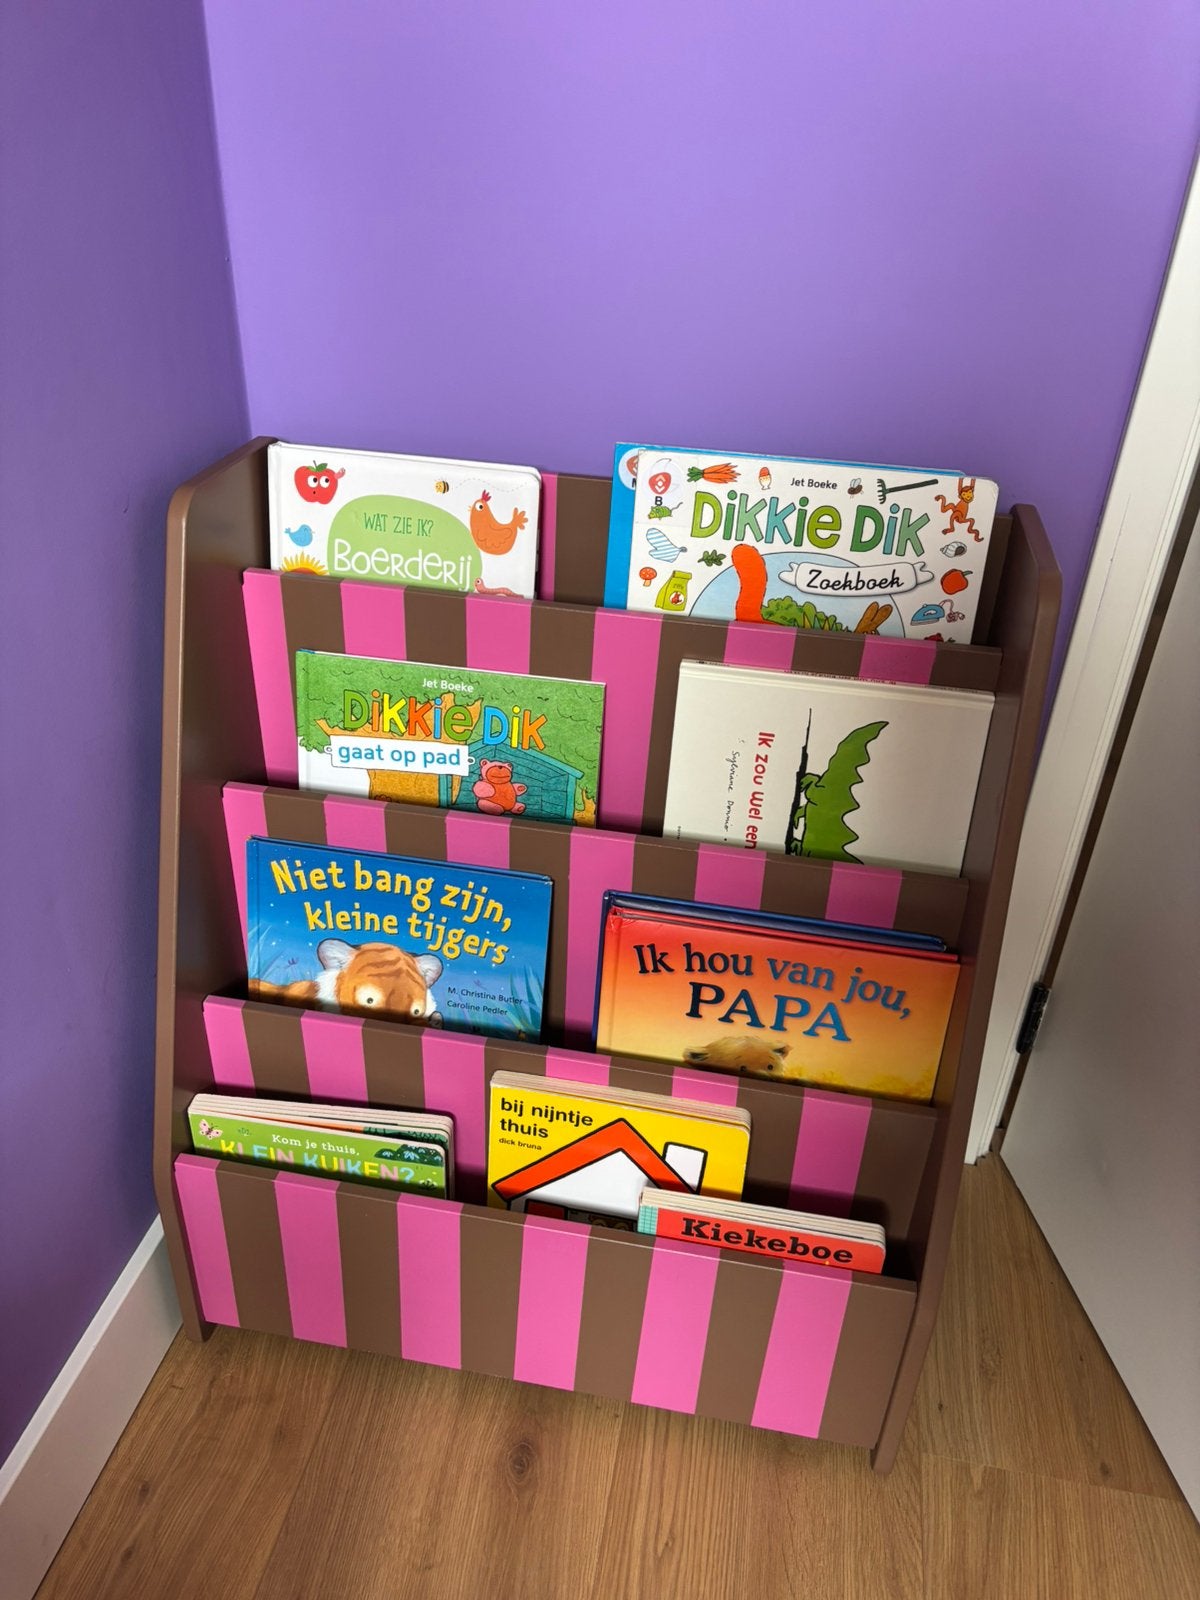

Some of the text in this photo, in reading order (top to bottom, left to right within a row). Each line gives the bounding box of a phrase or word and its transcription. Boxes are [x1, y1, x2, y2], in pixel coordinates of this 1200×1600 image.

[790, 477, 838, 490] Jet Boeke
[654, 495, 663, 506] B
[364, 512, 435, 538] WAT ZIE IK?
[333, 538, 472, 592] Boerderij
[806, 569, 904, 591] Zoekboek
[422, 677, 474, 693] Jet Boeke
[338, 744, 461, 768] gaat op pad
[725, 751, 741, 793] Sylviane
[744, 731, 776, 849] Ik zou wel een
[270, 859, 513, 933] Niet bang zijn,
[304, 901, 510, 965] kleine tijgers
[633, 942, 912, 1020] Ik hou van jou,
[447, 986, 523, 1005] M. Christina Butler
[447, 1000, 508, 1016] Caroline Pedler
[685, 981, 852, 1042] PAPA
[501, 1097, 594, 1127] bij nijntje
[272, 1133, 302, 1147] Kom
[305, 1139, 318, 1150] je
[500, 1118, 549, 1139] thuis
[498, 1137, 542, 1151] dick bruna
[303, 1152, 415, 1184] KUIKEN?
[680, 1217, 854, 1264] Kiekeboe
